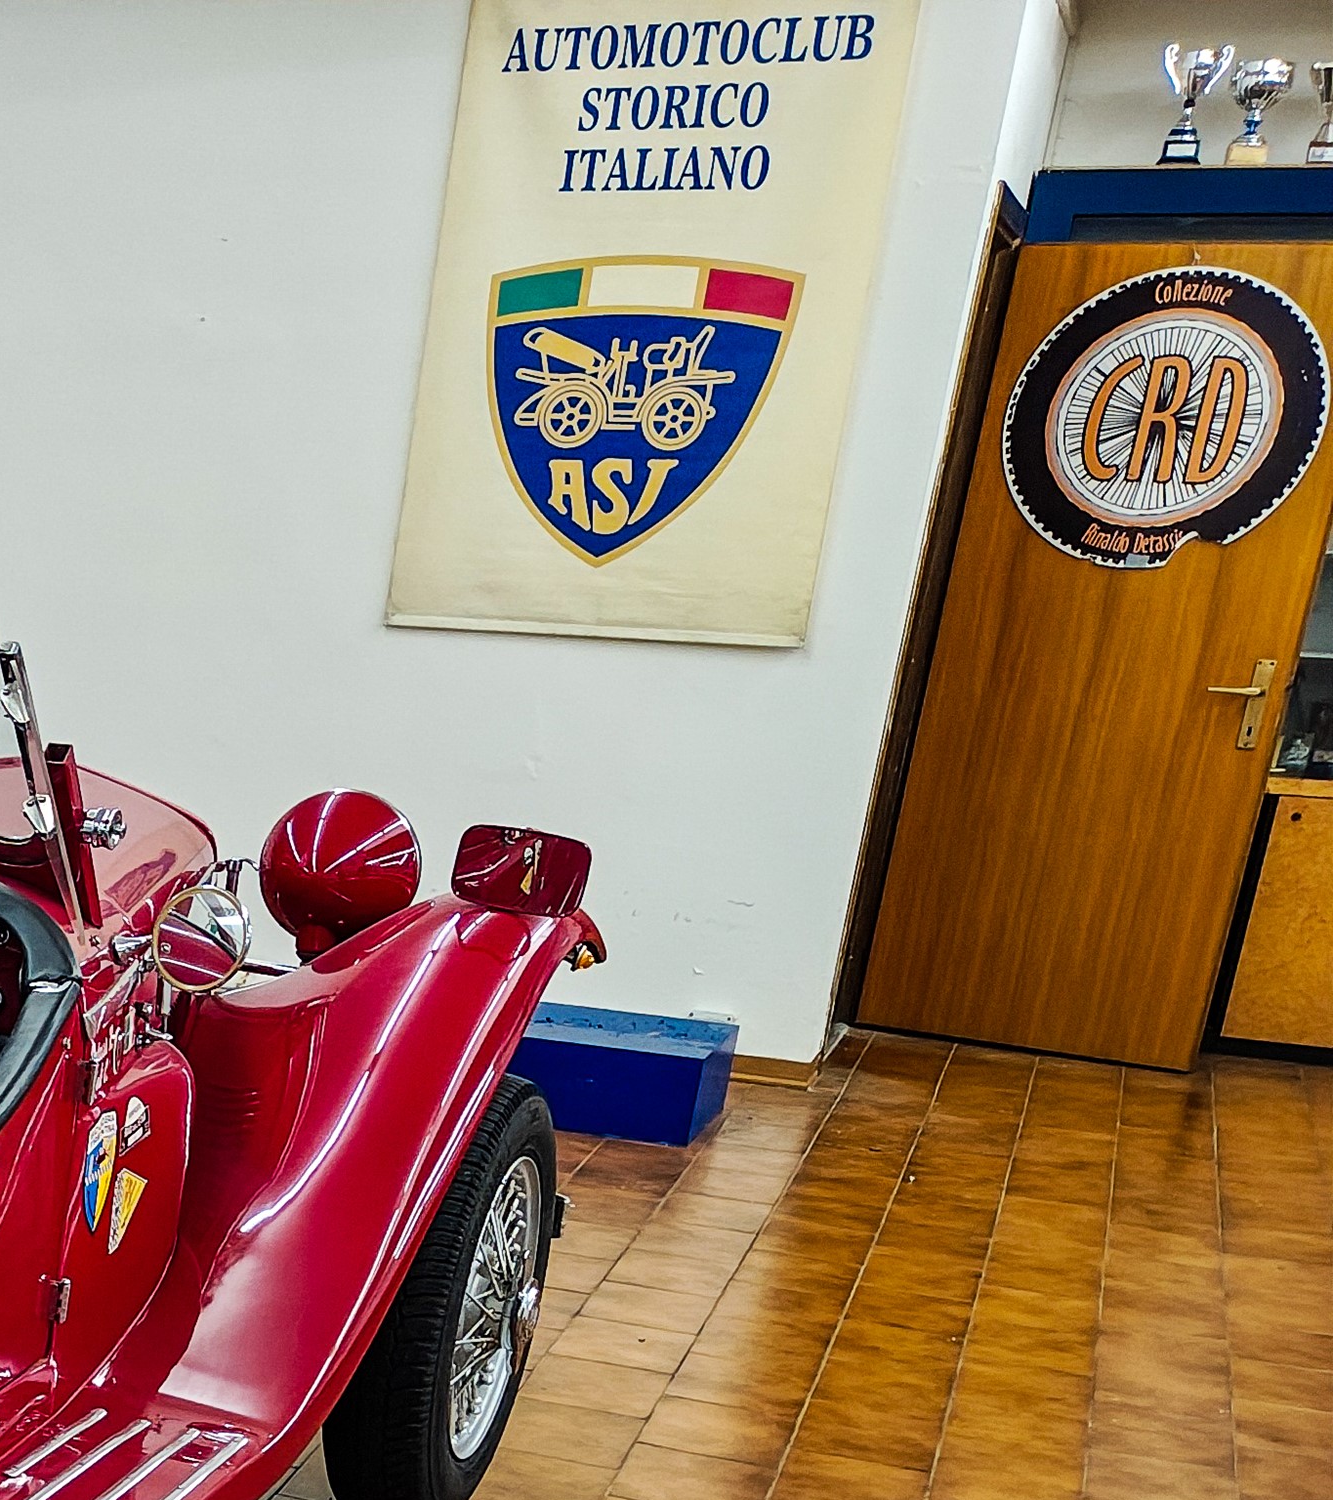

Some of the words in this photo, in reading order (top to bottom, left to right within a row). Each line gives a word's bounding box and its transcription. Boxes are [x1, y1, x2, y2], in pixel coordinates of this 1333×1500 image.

[502, 14, 875, 74] AUTOMOTOCLUB
[577, 81, 770, 131] STORICO
[558, 144, 771, 192] ITALIANO
[1155, 279, 1234, 306] Collezione
[1083, 354, 1247, 483] CRD
[547, 457, 680, 535] ASI
[1080, 523, 1130, 553] Rinaldo
